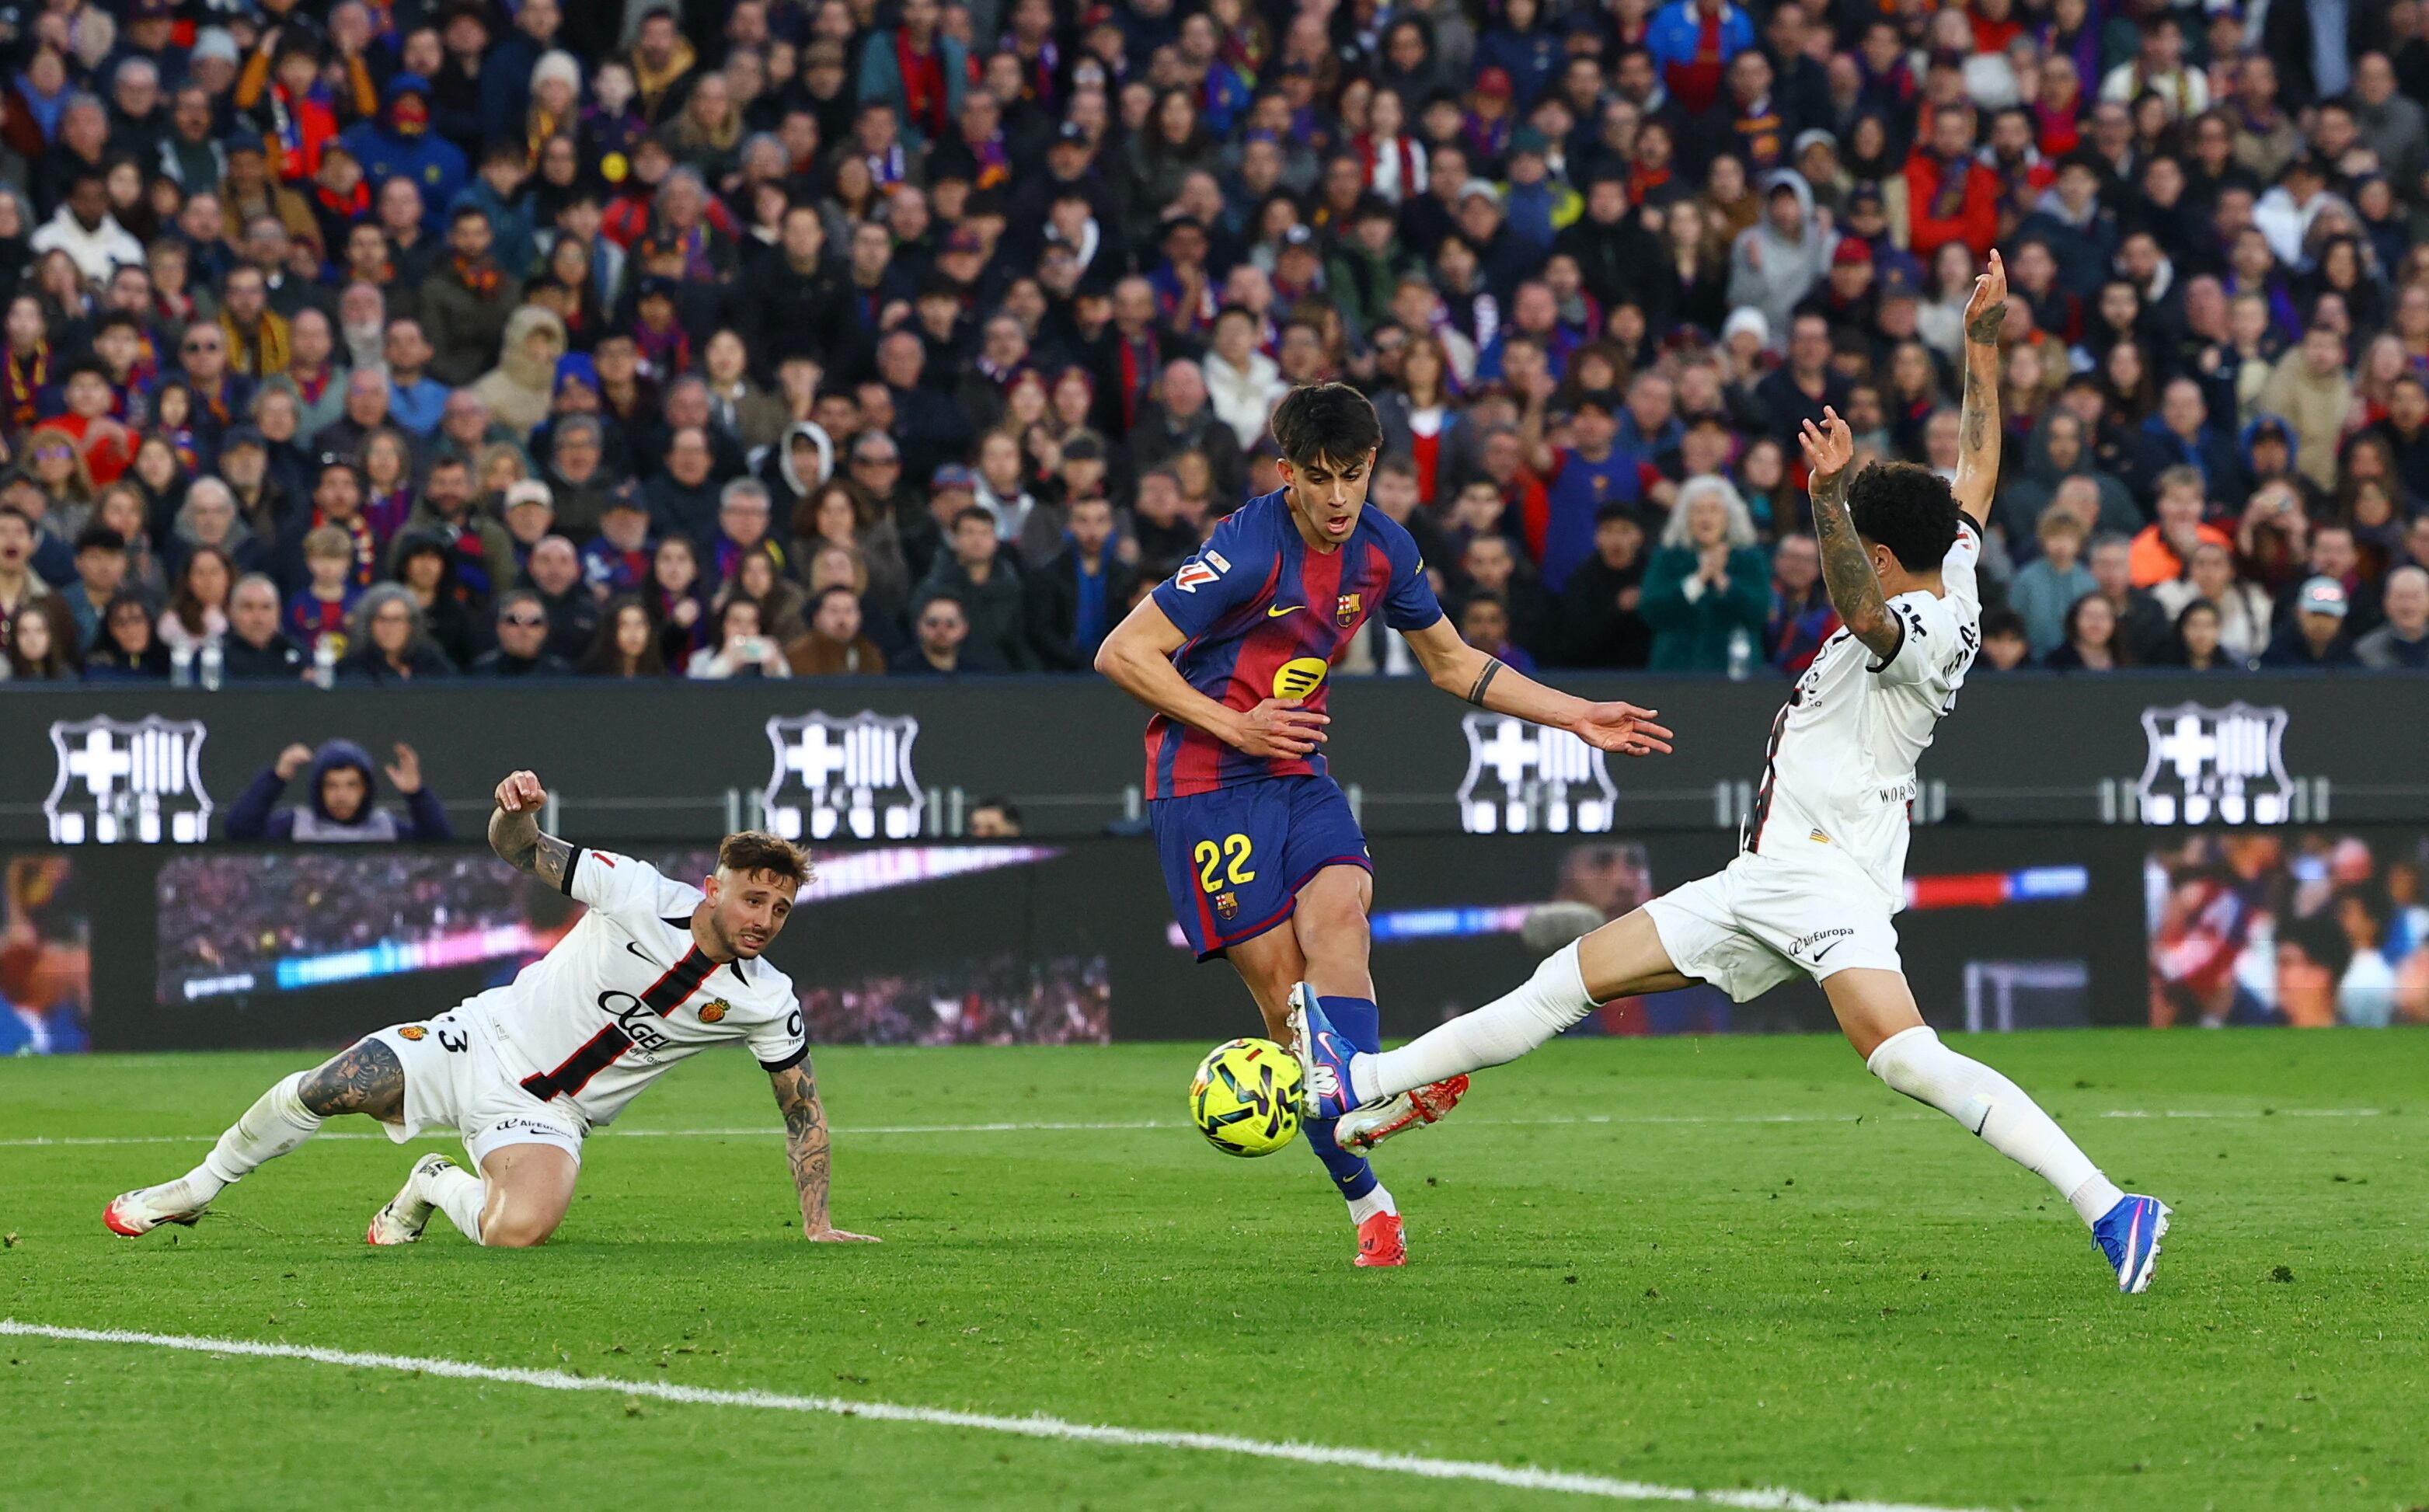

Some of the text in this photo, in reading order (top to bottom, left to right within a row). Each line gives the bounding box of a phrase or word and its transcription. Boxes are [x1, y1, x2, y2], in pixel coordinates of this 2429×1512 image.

[1880, 778, 1916, 803] WOR
[1194, 832, 1256, 894] 22
[1803, 928, 1855, 949] AirEuropa
